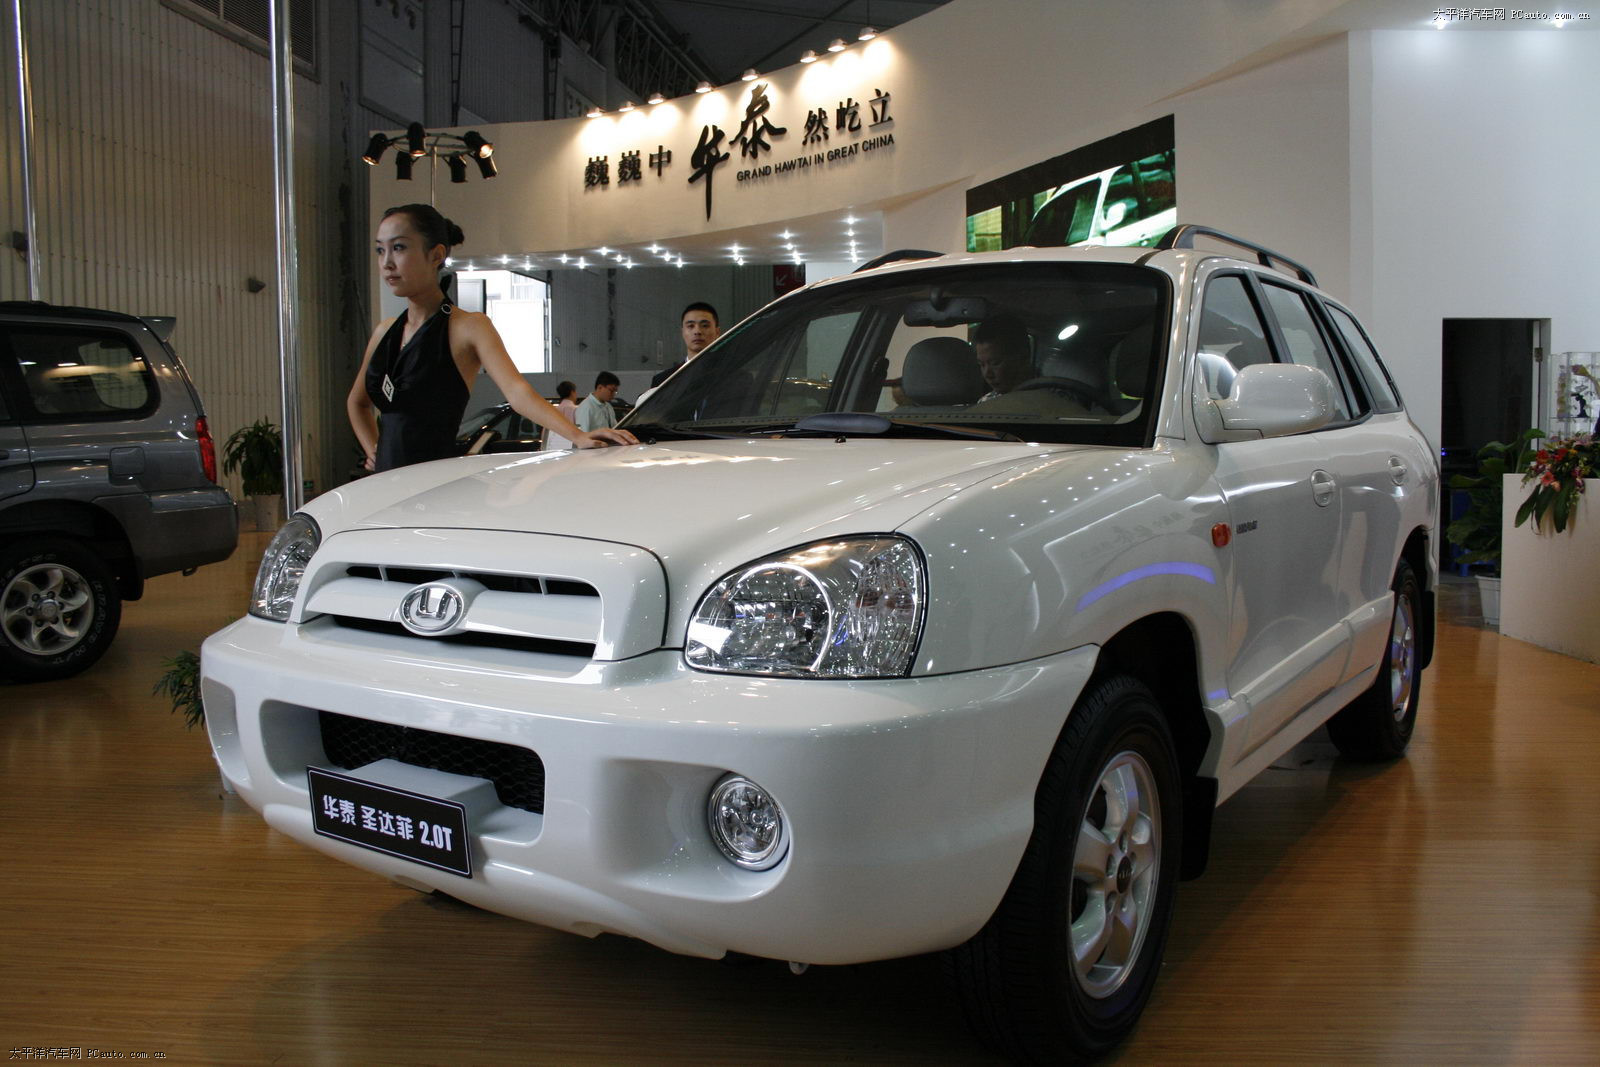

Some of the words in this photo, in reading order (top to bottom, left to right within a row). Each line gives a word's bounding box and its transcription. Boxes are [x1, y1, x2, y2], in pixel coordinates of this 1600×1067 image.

[736, 165, 772, 182] GRAND
[774, 156, 812, 174] HAWTAI
[814, 152, 825, 166] IN
[827, 143, 859, 162] GREAT
[861, 134, 895, 152] CHINA
[323, 794, 357, 826] 华泰
[361, 805, 414, 841] 圣达菲
[419, 821, 452, 851] 2.0T
